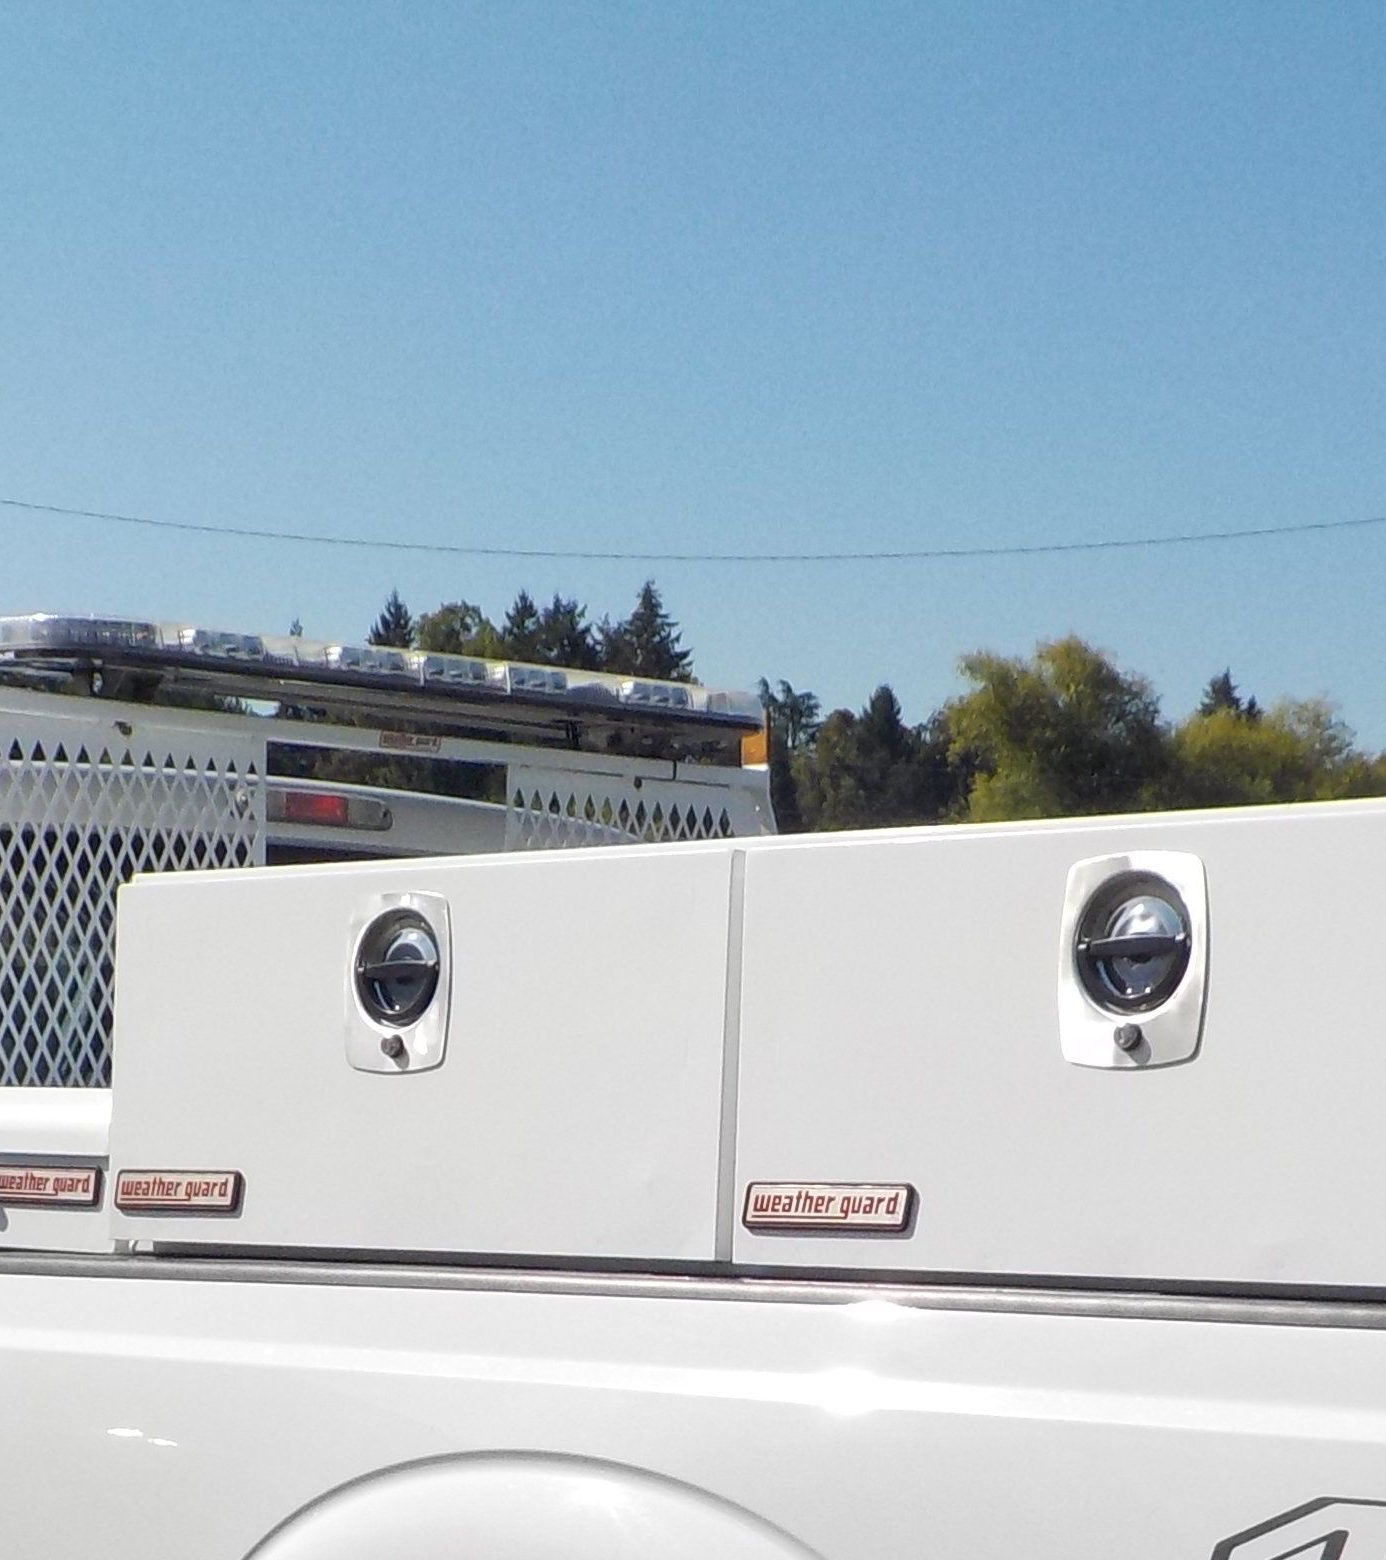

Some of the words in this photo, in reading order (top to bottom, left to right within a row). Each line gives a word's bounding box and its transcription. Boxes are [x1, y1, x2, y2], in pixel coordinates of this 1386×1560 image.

[52, 1174, 90, 1195] guard
[120, 1176, 181, 1196] weather
[183, 1178, 229, 1201] guard
[753, 1190, 836, 1213] weather
[839, 1192, 900, 1219] guard
